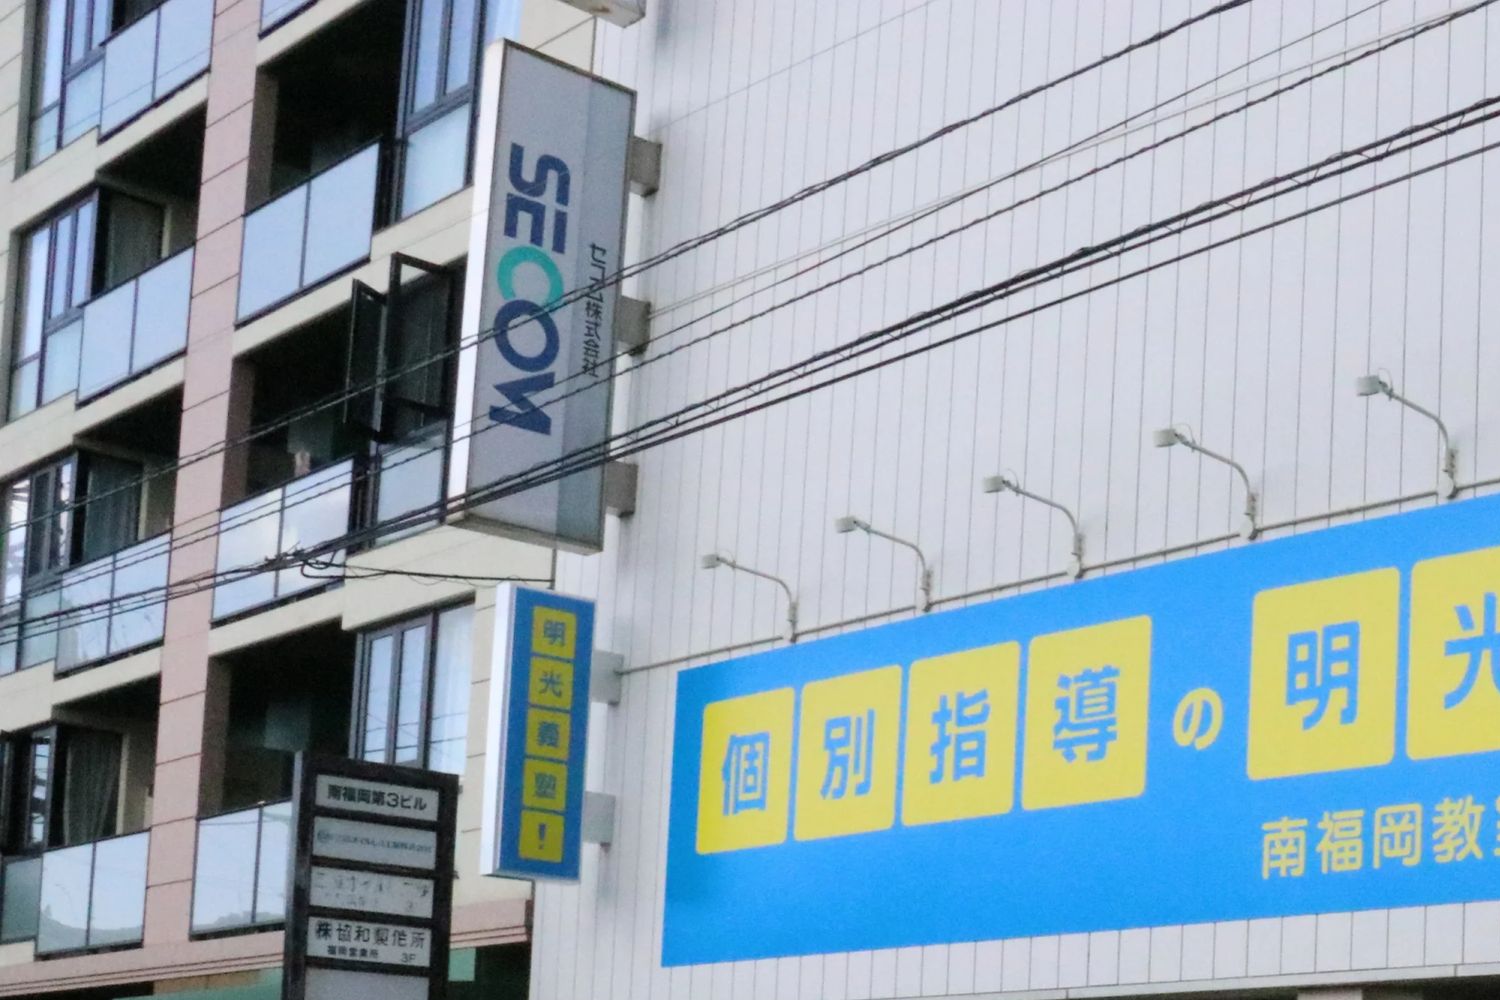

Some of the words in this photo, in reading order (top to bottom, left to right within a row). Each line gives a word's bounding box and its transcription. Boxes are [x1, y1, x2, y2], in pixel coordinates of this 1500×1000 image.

[489, 142, 571, 437] SECOM
[582, 243, 607, 378] セコム株式会社
[327, 784, 427, 811] 南福岡第3ビル
[533, 620, 566, 850] 明光義塾!
